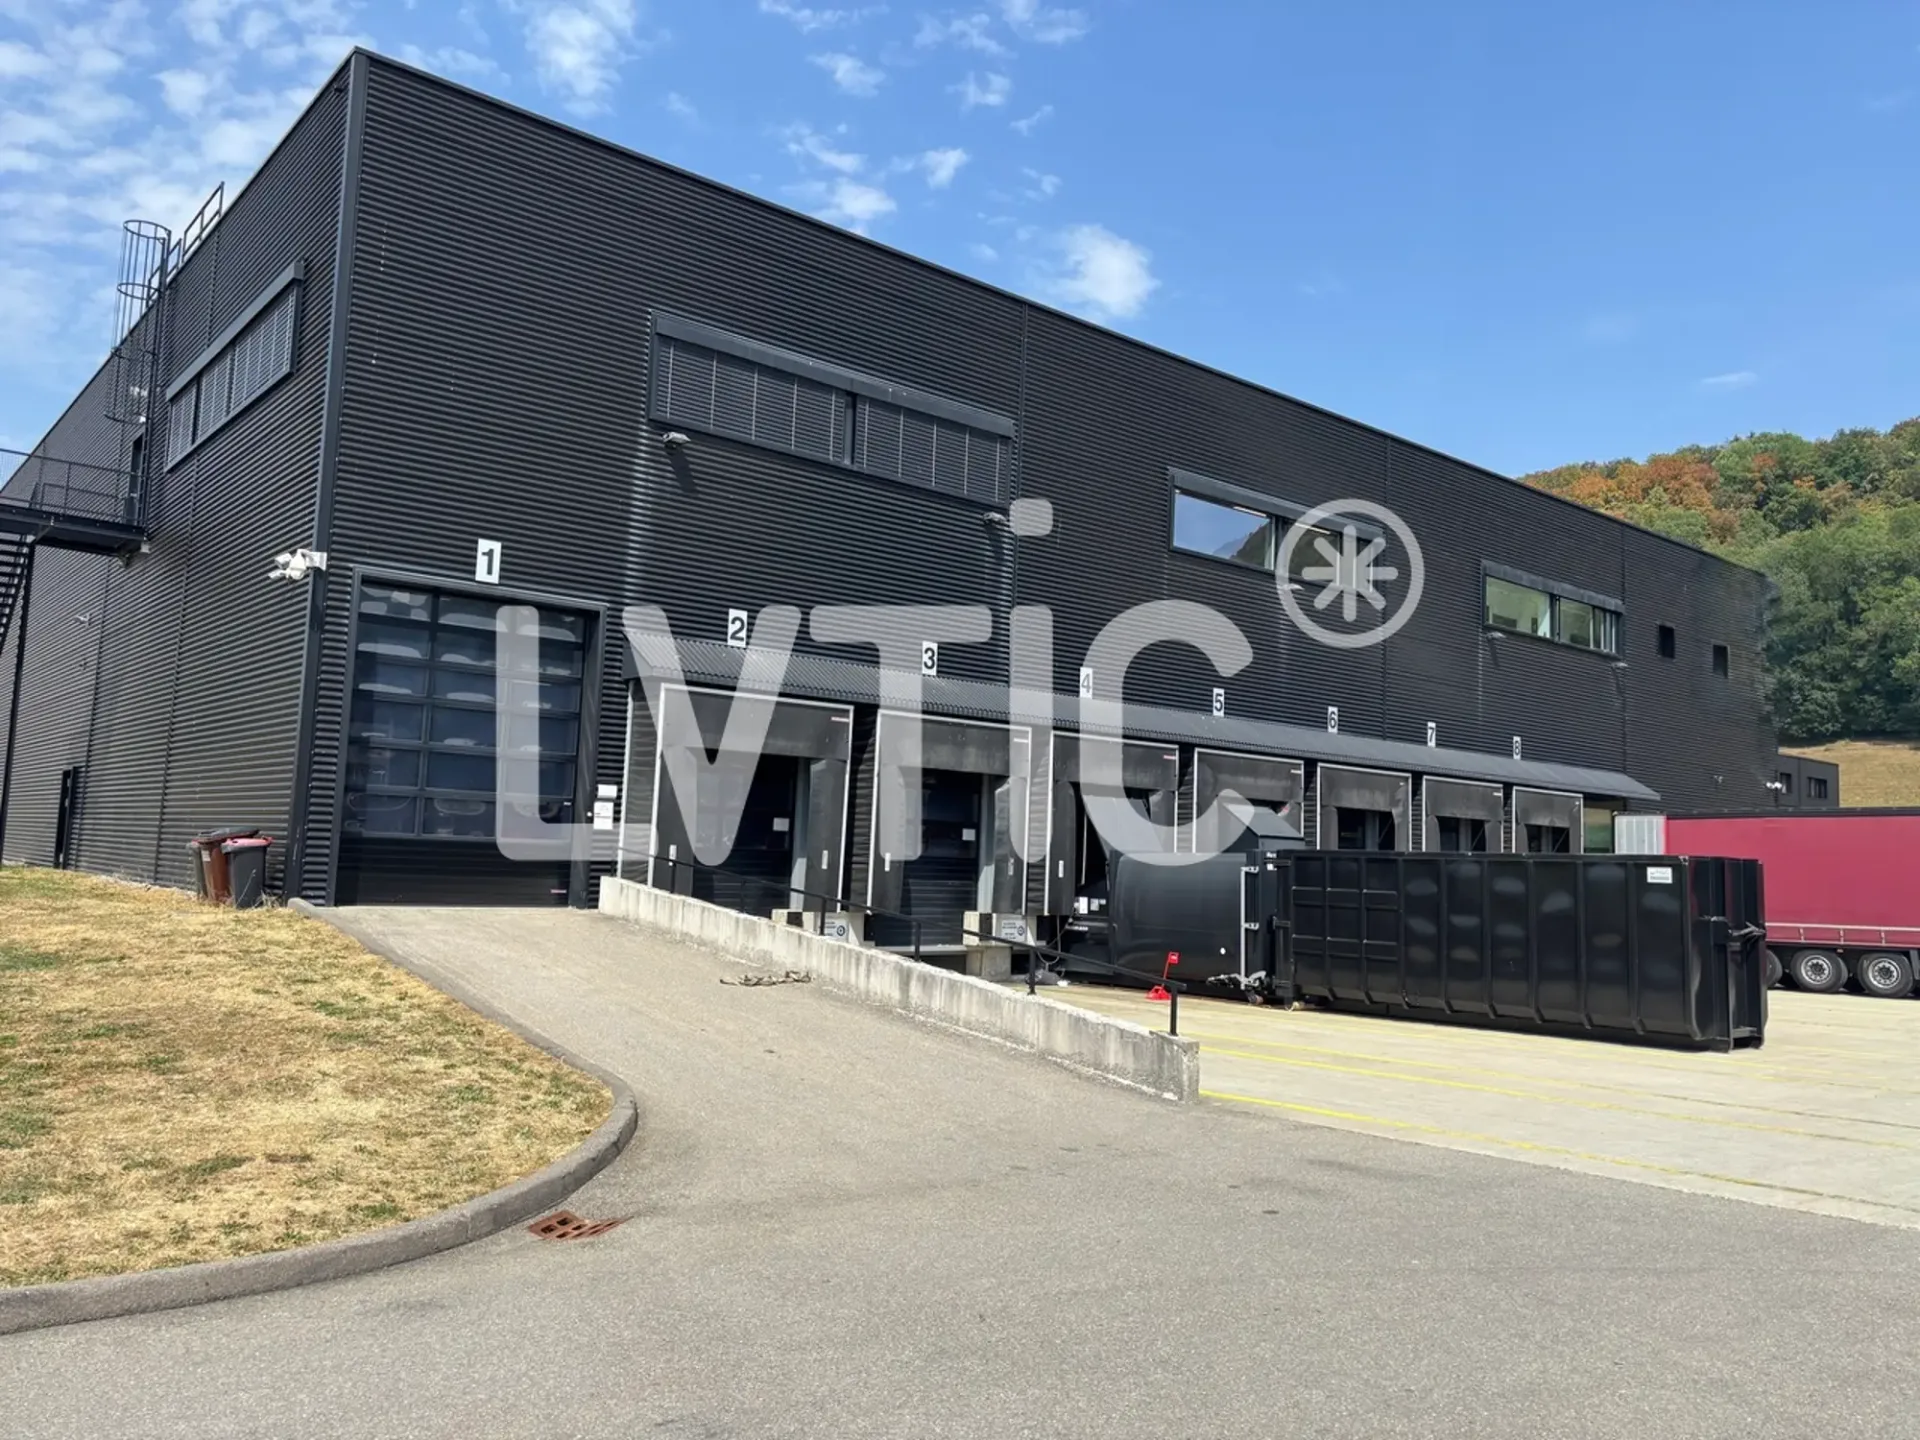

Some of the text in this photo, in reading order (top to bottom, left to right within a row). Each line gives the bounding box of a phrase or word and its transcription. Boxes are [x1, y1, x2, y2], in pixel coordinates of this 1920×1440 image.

[481, 548, 495, 576] 1
[730, 616, 746, 641] 2
[923, 647, 936, 670] 3
[1081, 673, 1092, 694] 4
[1214, 692, 1224, 712] 5
[1328, 710, 1338, 729] 6
[1427, 726, 1436, 743] 7
